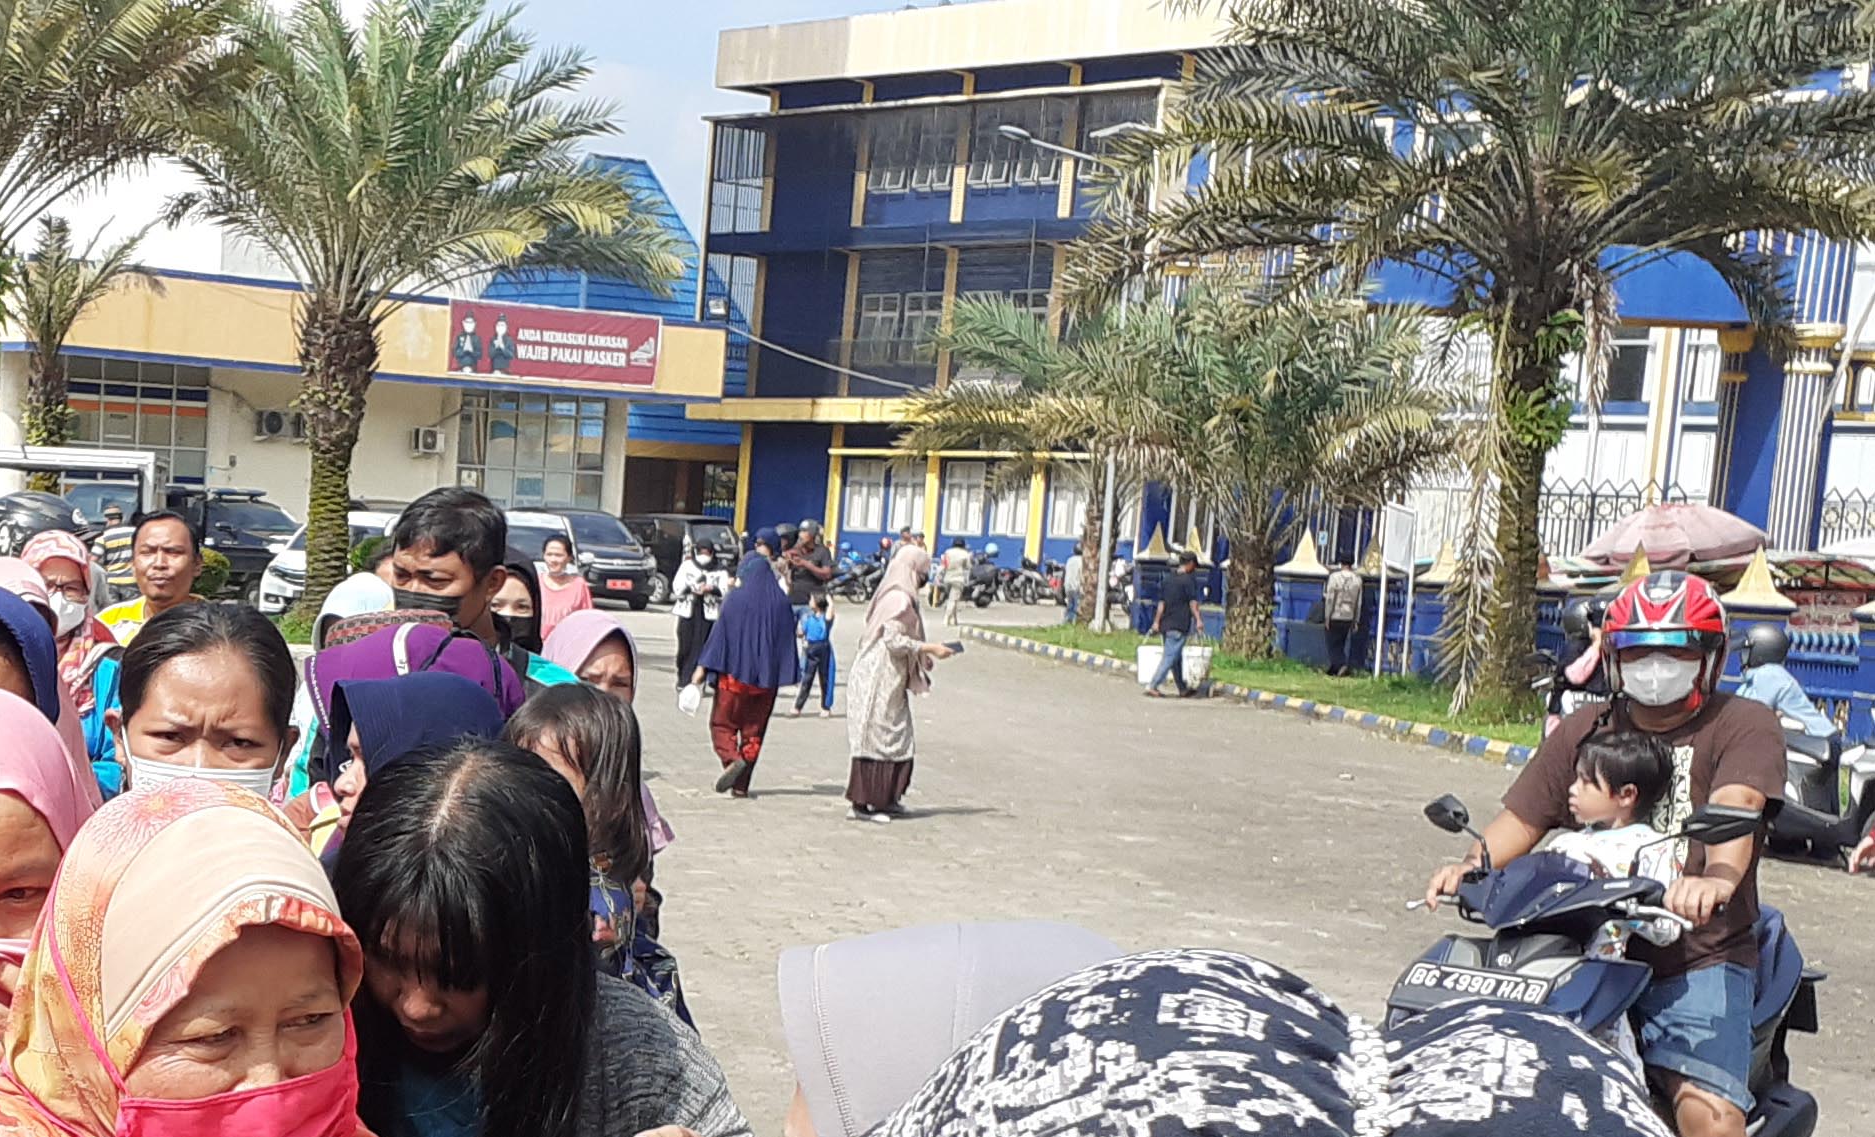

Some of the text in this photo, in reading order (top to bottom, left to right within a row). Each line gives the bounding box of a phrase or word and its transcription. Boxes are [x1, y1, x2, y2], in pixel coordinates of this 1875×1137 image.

[517, 328, 541, 341] ANDA
[542, 330, 586, 345] MEMASUKI
[516, 344, 627, 368] WAJIB PAKAI MASKER
[1411, 968, 1540, 1001] BG 4990 HAB
